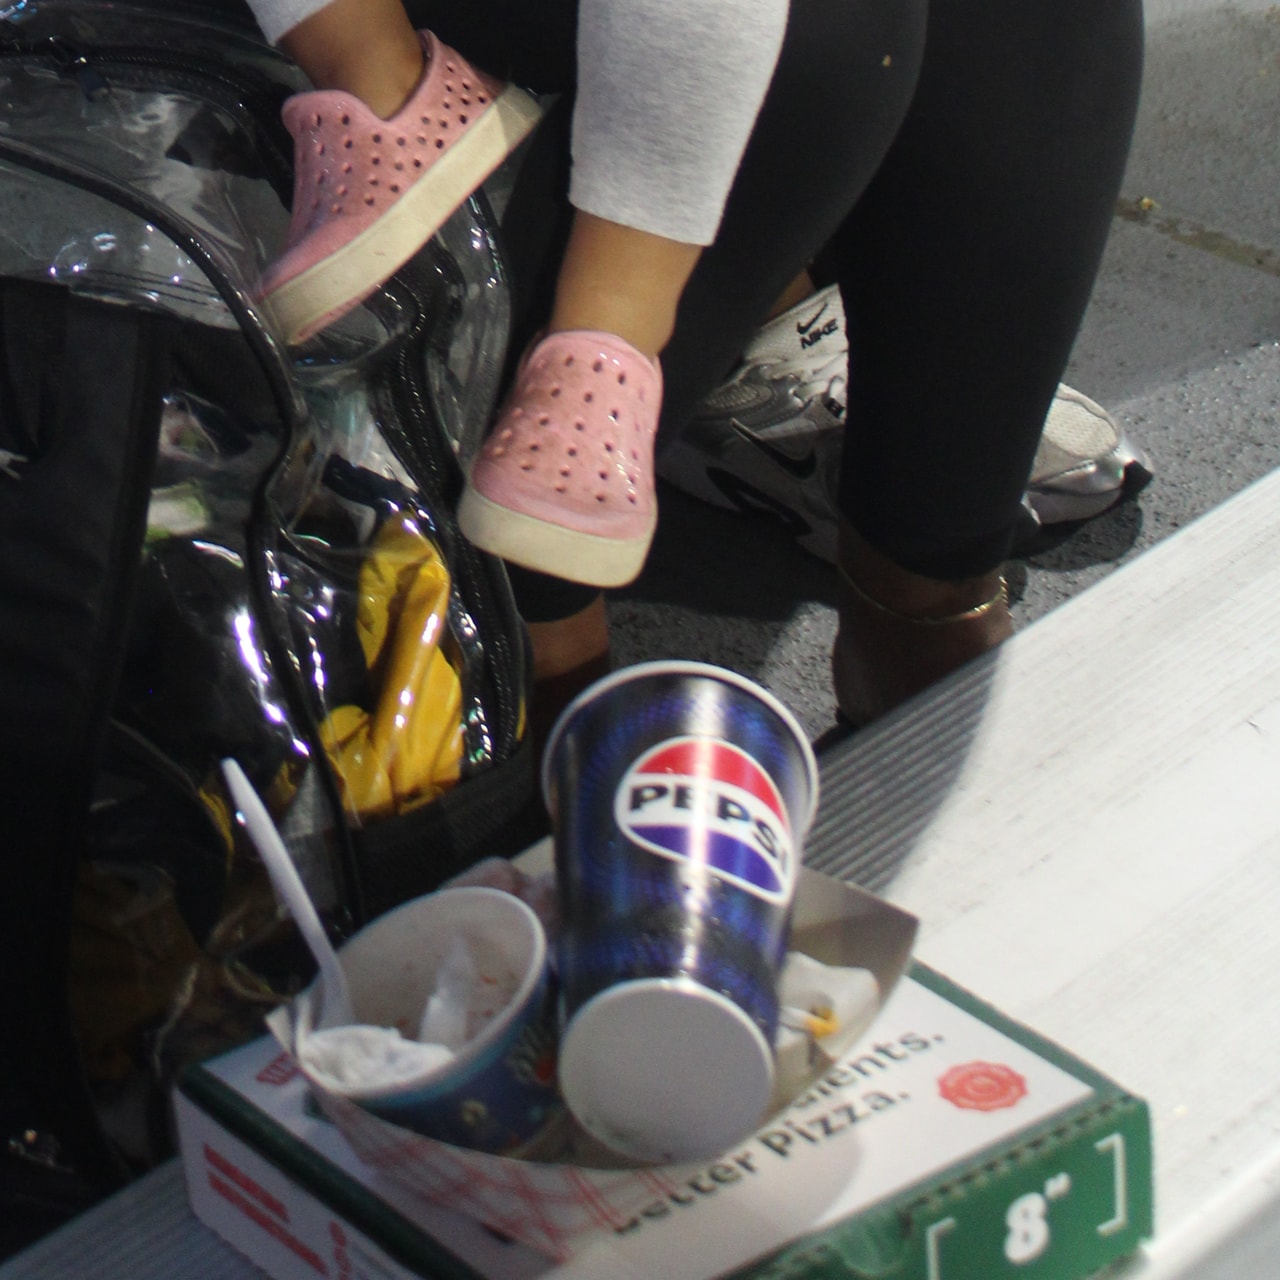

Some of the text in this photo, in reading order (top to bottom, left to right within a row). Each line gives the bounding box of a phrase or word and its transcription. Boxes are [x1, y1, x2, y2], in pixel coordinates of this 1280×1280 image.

[801, 318, 838, 350] NIKE
[629, 784, 788, 874] PEPSI
[614, 1090, 909, 1235] etter Pizza.
